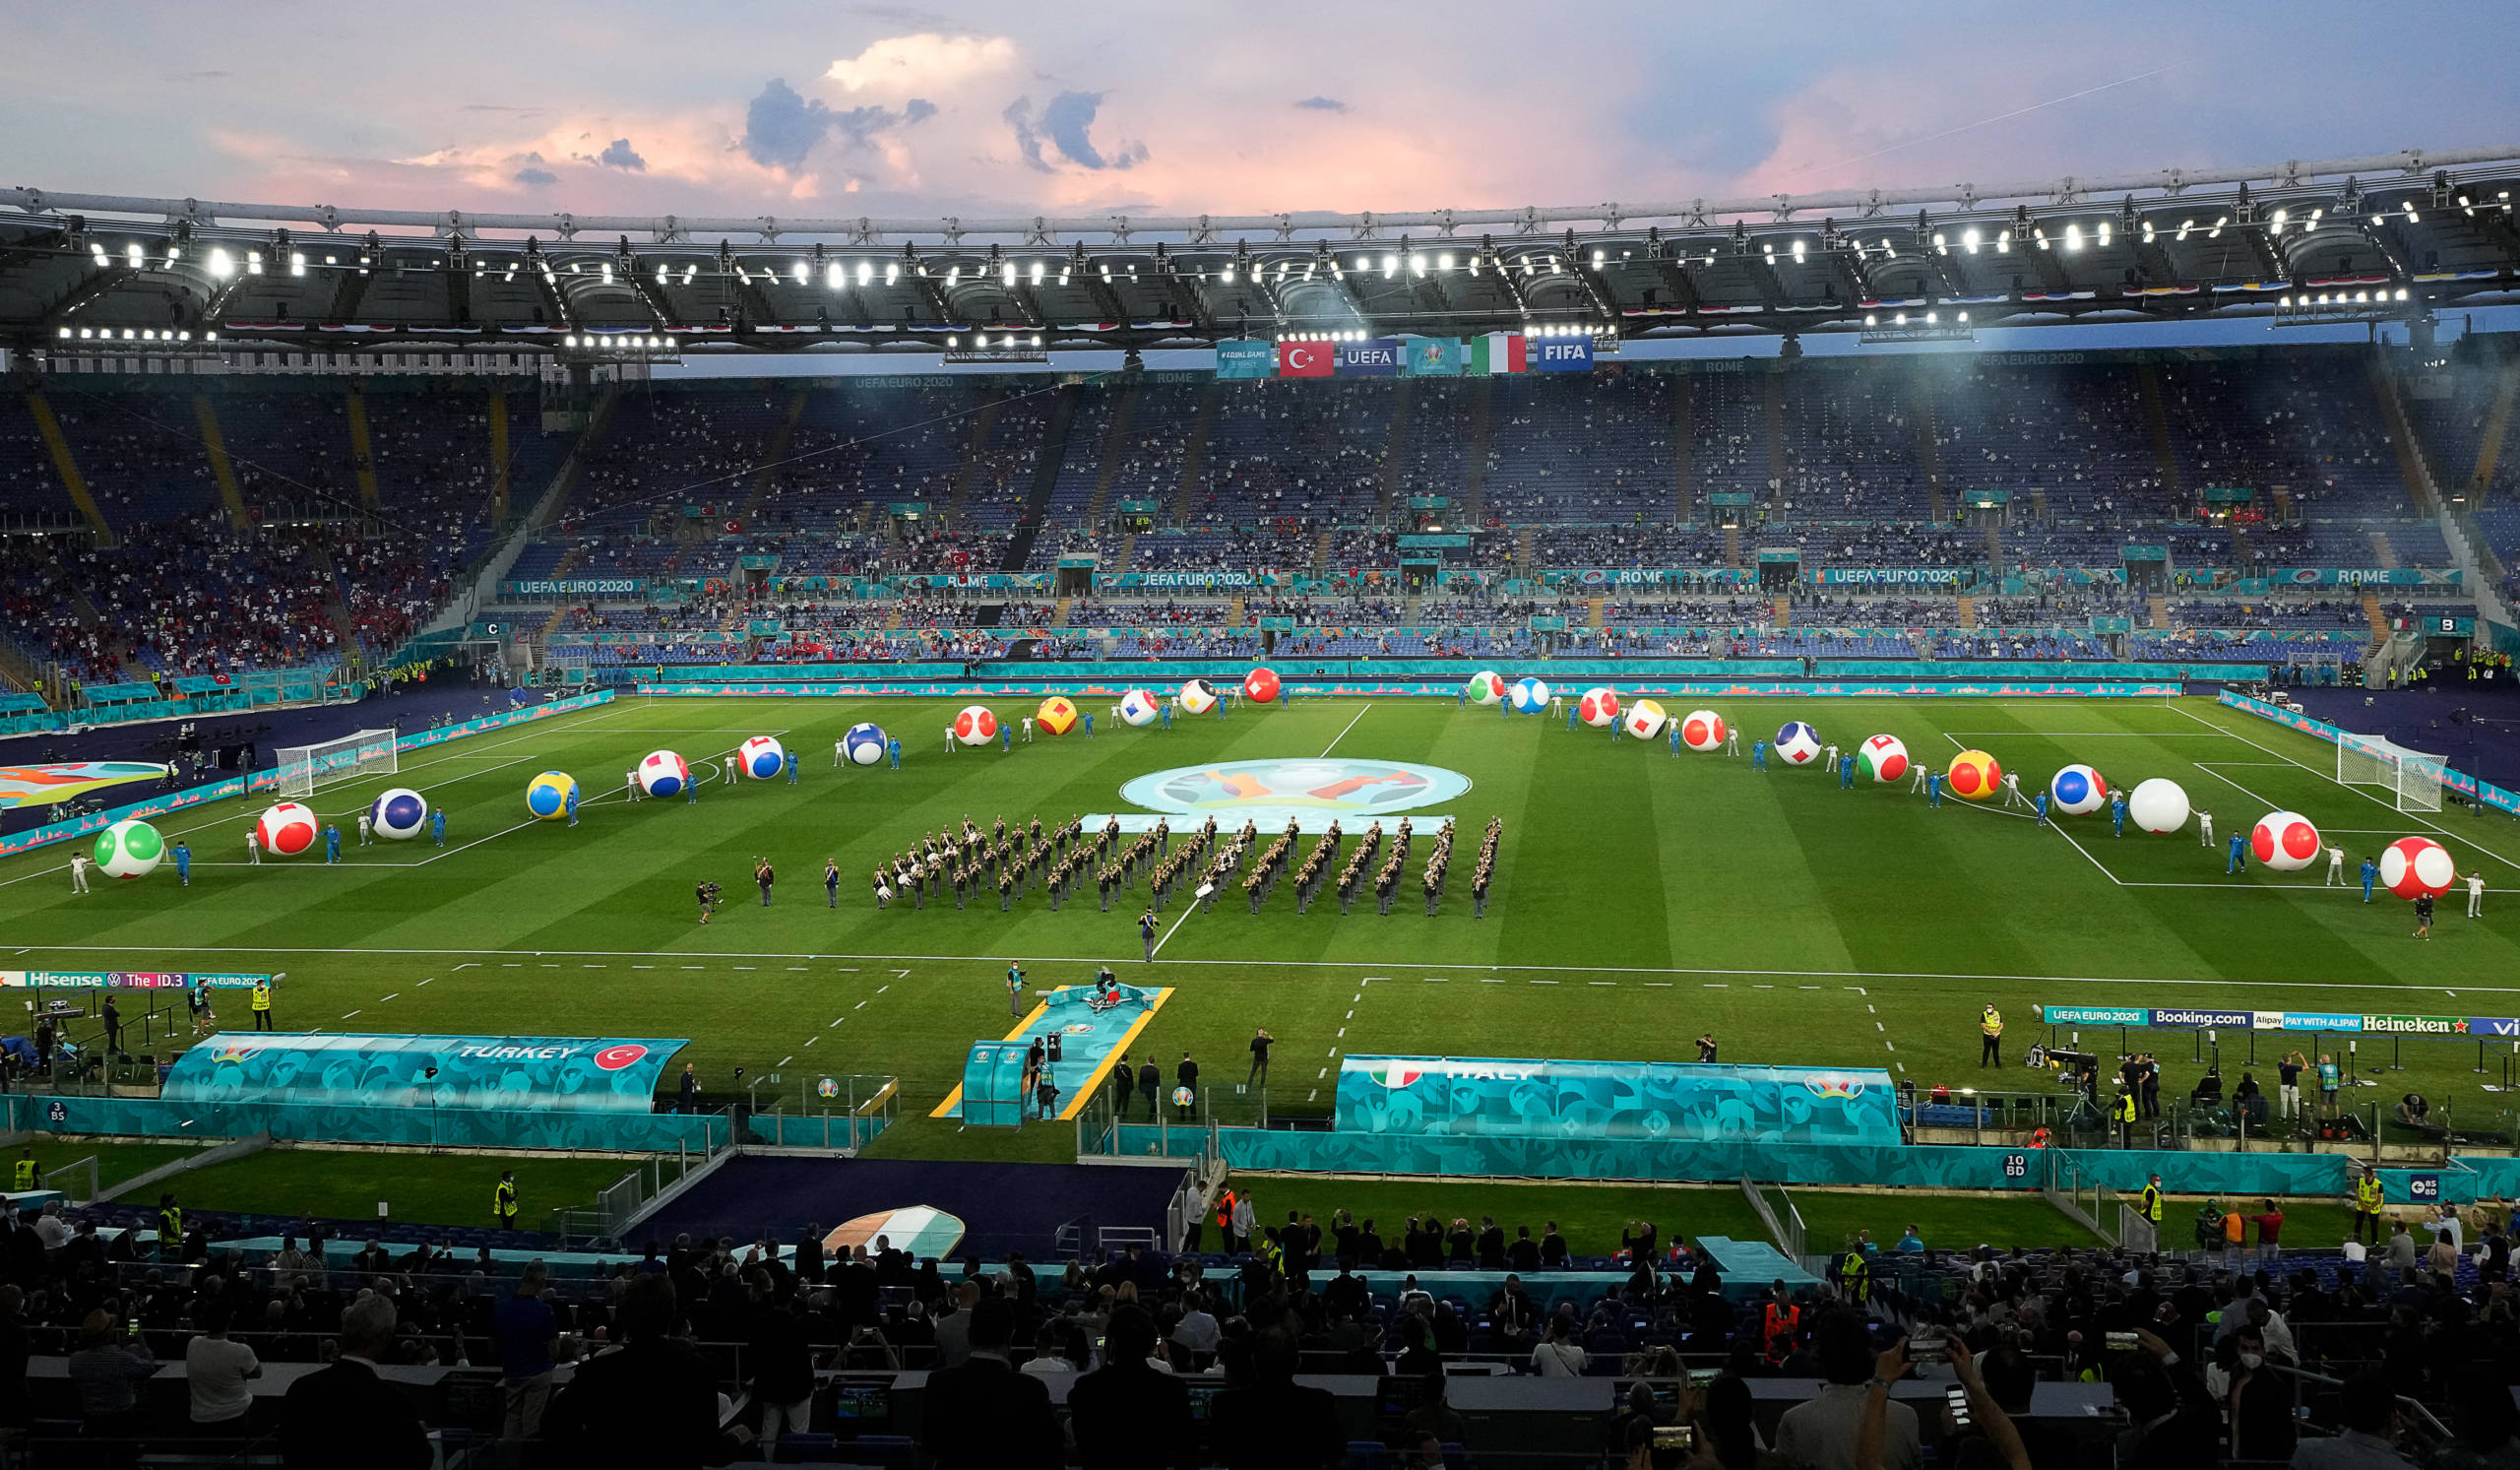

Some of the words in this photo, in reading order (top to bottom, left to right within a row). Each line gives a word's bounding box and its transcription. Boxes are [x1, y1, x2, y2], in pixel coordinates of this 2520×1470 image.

[1348, 352, 1392, 364] UEFA
[1544, 345, 1586, 360] FIFA
[2010, 354, 2048, 365] EURO
[2048, 352, 2084, 364] 2020
[1706, 361, 1745, 372] ROME
[854, 377, 886, 388] UEFA
[889, 377, 922, 388] EURO
[922, 376, 954, 387] 2020
[1157, 372, 1194, 383] ROME
[947, 575, 988, 587] RME
[1835, 570, 1875, 583] UEFA
[2338, 570, 2390, 583] ROME
[520, 581, 558, 593] UEFA
[559, 581, 598, 593] EURO
[598, 580, 634, 593] 2020
[488, 623, 498, 634] C
[2442, 619, 2453, 630] B
[30, 972, 102, 987] Hisense
[126, 974, 151, 987] The
[157, 975, 183, 988] ID.3
[219, 977, 241, 986] EURO
[242, 977, 264, 986] 202
[2053, 1010, 2082, 1020] UEFA
[2082, 1010, 2111, 1021] EURO
[2111, 1011, 2139, 1022] 2020
[2156, 1010, 2246, 1027] Booking.com
[2255, 1015, 2283, 1026] Alipay
[2285, 1016, 2304, 1026] PAY
[2306, 1017, 2328, 1027] WITH
[2328, 1018, 2361, 1028] ALIPAY
[2362, 1016, 2450, 1034] Heineken
[460, 1046, 583, 1058] TURKEY
[54, 1102, 61, 1112] 3
[51, 1112, 65, 1120] BS
[2007, 1155, 2024, 1166] 10
[2006, 1166, 2025, 1177] BD
